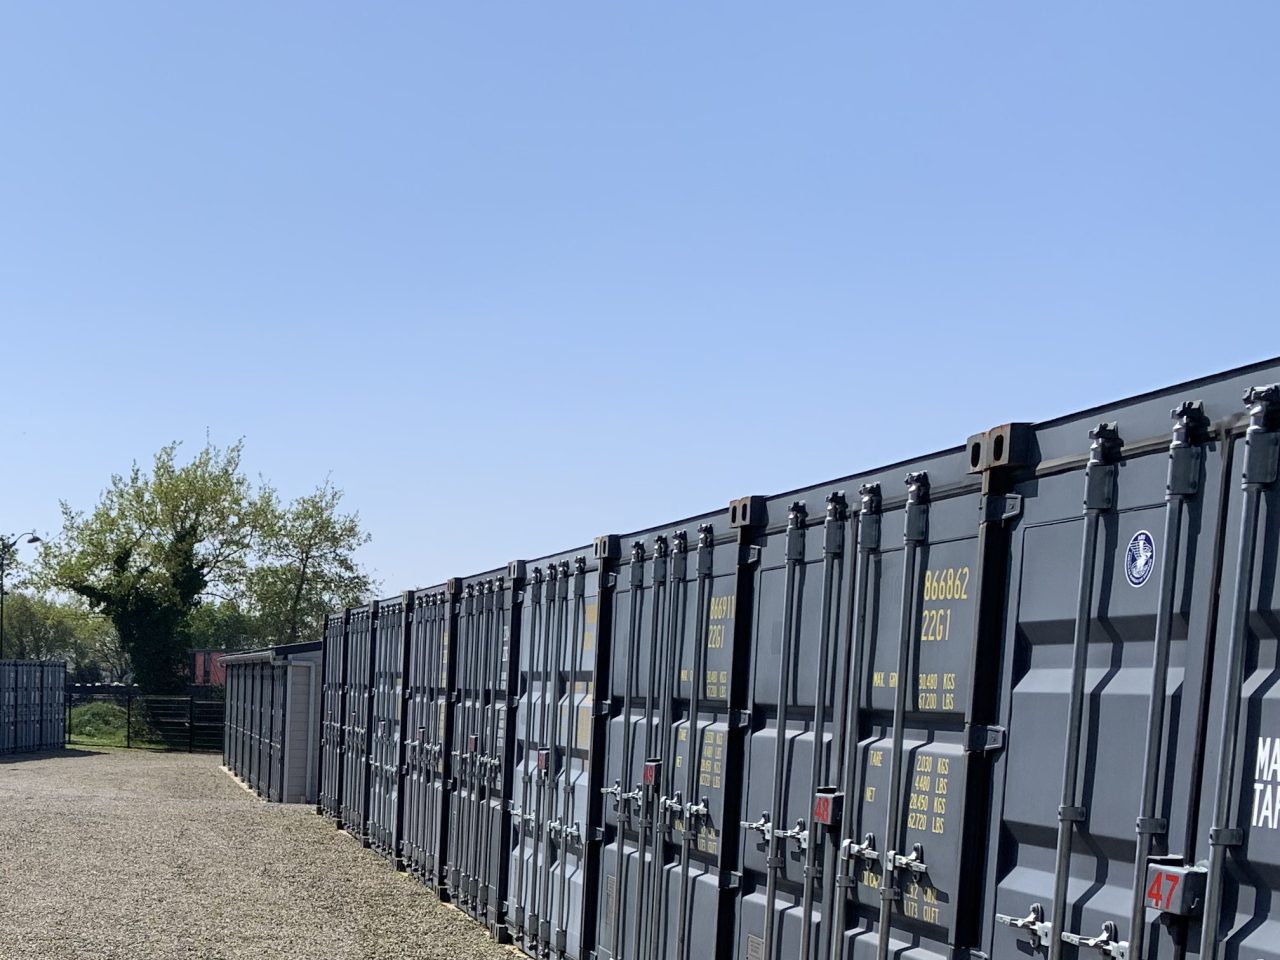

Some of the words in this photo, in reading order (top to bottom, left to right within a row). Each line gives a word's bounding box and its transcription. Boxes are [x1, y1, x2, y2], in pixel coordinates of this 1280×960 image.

[923, 567, 969, 600] 866862
[921, 609, 951, 641] 22G1
[942, 673, 956, 690] KGS
[941, 693, 955, 710] LBS
[869, 750, 883, 767] TARE
[937, 757, 949, 775] KGS
[935, 777, 948, 794] LBS
[814, 797, 829, 823] 48
[933, 796, 946, 814] KGS
[932, 816, 945, 834] LBS
[1147, 872, 1180, 910] 47
